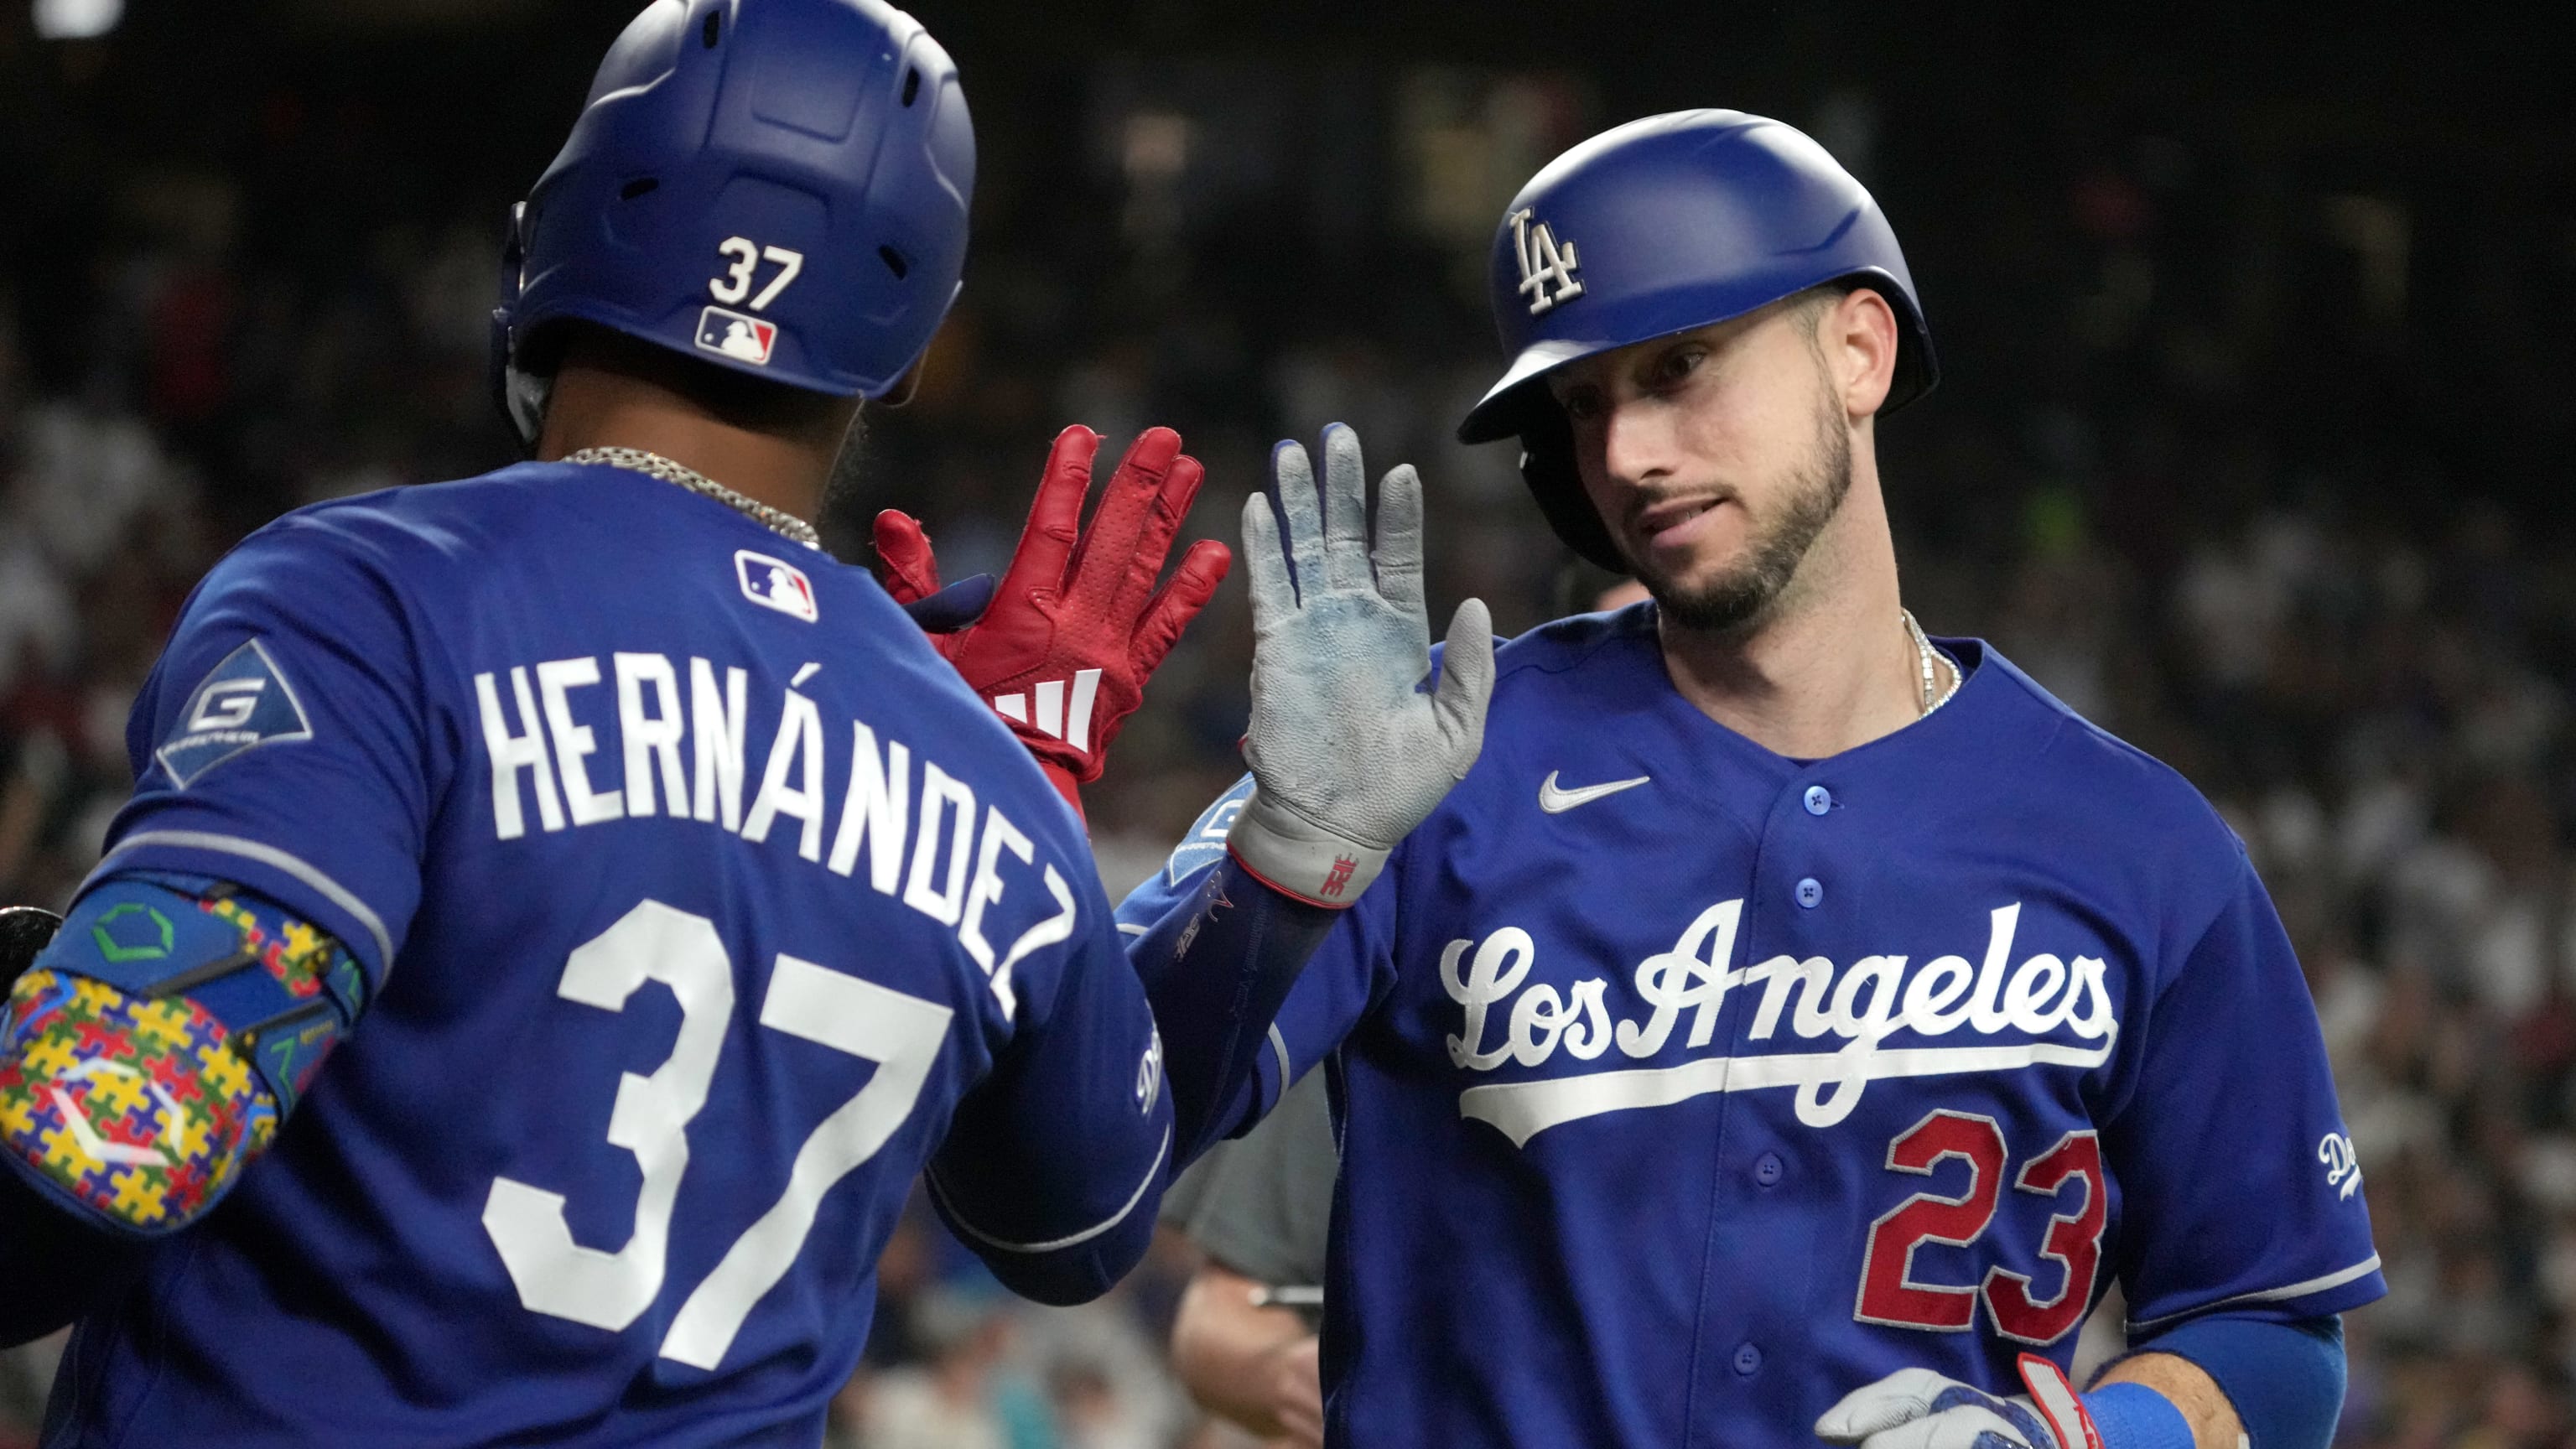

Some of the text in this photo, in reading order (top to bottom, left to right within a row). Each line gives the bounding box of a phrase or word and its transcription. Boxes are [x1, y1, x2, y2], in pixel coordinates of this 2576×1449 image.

[709, 236, 804, 311] 37
[1509, 207, 1584, 316] LA
[475, 652, 1077, 1022] HERNÁNDEZ
[1439, 897, 2118, 1129] Los Angeles
[481, 897, 955, 1372] 37
[1852, 1108, 2109, 1347] 23
